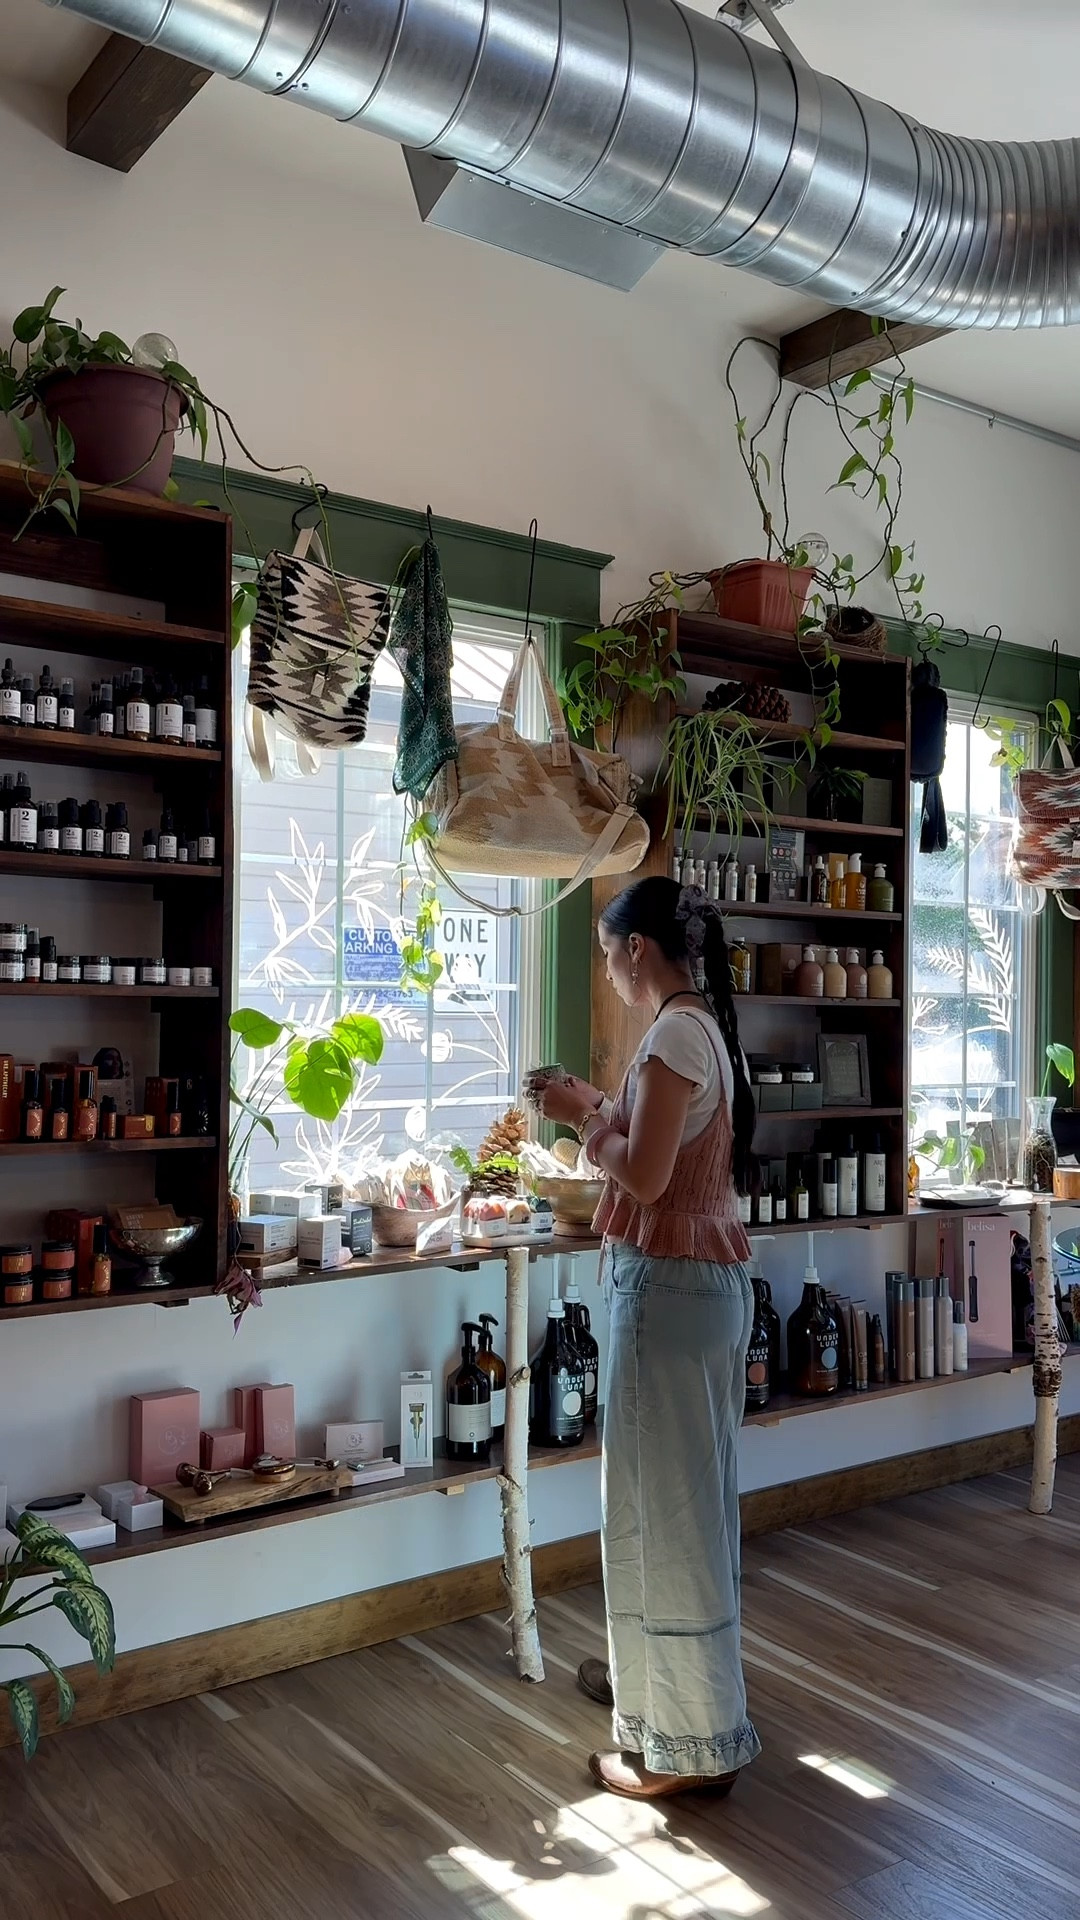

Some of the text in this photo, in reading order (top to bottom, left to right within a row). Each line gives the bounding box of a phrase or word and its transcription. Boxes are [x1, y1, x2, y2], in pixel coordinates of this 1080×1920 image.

[21, 811, 29, 820] 2
[443, 917, 488, 943] ONE
[343, 941, 393, 954] ARKING
[444, 953, 486, 978] WY
[967, 1221, 995, 1232] belisa
[816, 1333, 839, 1342] UNDER
[820, 1340, 838, 1348] LUNA
[748, 1347, 769, 1355] NDER
[746, 1354, 768, 1362] LUNA
[557, 1375, 584, 1384] UNDER
